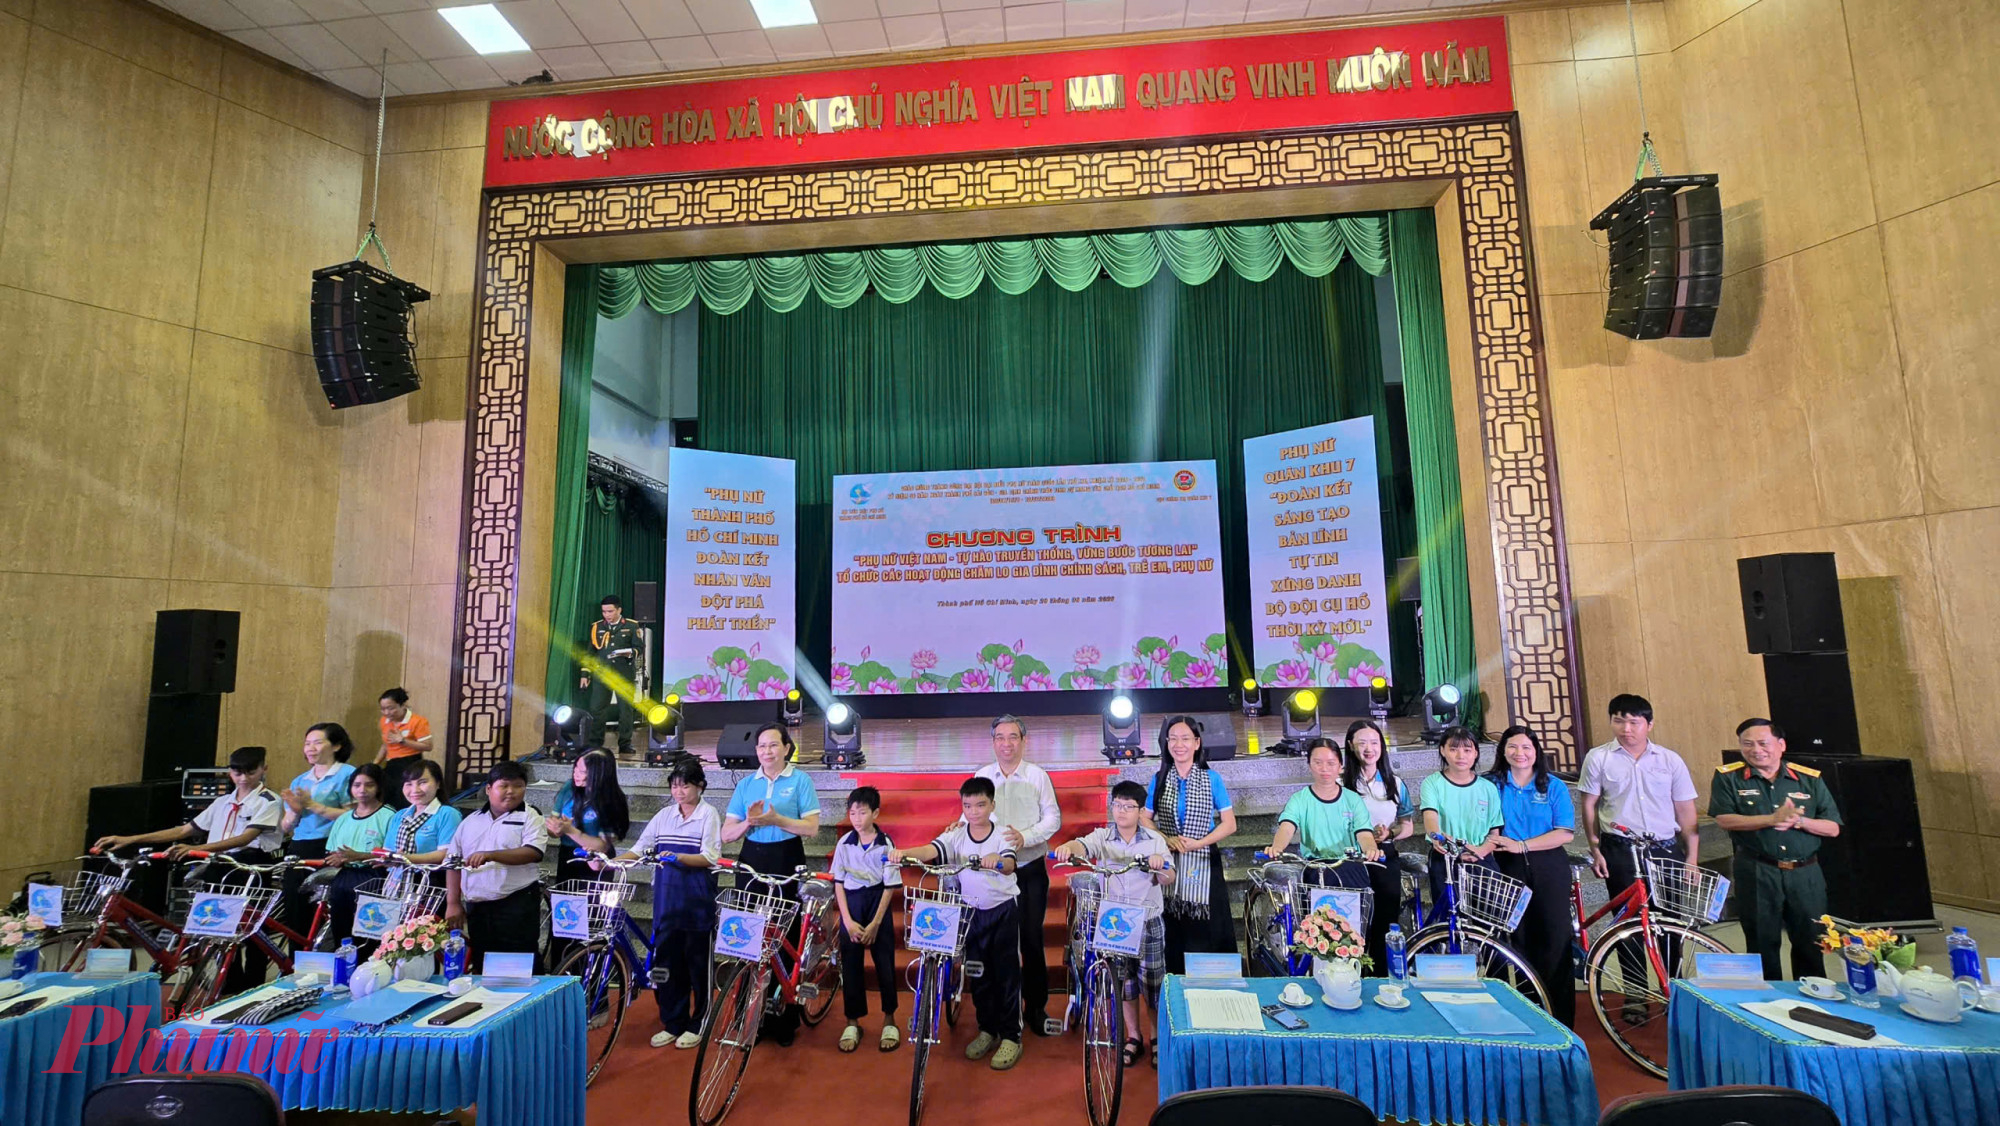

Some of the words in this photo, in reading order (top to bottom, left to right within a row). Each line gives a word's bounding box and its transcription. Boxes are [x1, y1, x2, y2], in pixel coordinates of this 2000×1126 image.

[503, 113, 575, 159] NƯỚC
[581, 109, 654, 161] CỘNG
[661, 101, 716, 146] HÒA
[727, 97, 763, 140] XÃ
[773, 93, 818, 145] HỘI
[828, 82, 883, 130] CHỦ
[895, 81, 978, 127] NGHĨA
[990, 75, 1053, 128] VIỆT
[1065, 73, 1124, 112] NAM
[1136, 67, 1236, 110] QUANG
[1246, 61, 1316, 99] VINH
[1327, 46, 1412, 93] MUÔN
[1421, 40, 1491, 87] NĂM
[1279, 444, 1309, 461] PHỤ
[1312, 437, 1337, 455] NỮ
[1309, 460, 1343, 478] KHU
[1345, 458, 1355, 472] 7
[743, 490, 764, 504] NỮ
[1323, 479, 1352, 497] KẾT
[692, 508, 742, 523] THÀNH
[746, 510, 775, 525] PHỐ
[1274, 508, 1314, 527] SÁNG
[1317, 505, 1350, 523] TẠO
[713, 529, 739, 544] CHÍ
[742, 532, 779, 546] MINH
[926, 528, 1035, 549] CHƯƠNG
[1043, 521, 1122, 545] TRÌNH
[1312, 527, 1348, 544] LĨNH
[696, 550, 740, 565] ĐOÀN
[743, 551, 769, 566] KẾT
[882, 552, 898, 566] NỮ
[899, 552, 921, 567] VIỆT
[923, 552, 947, 565] NAM
[956, 552, 970, 566] TỰ
[972, 549, 993, 562] HÀO
[995, 547, 1035, 562] TRUYỀN
[1077, 545, 1105, 560] VỮNG
[1107, 545, 1136, 558] BƯỚC
[1138, 545, 1172, 557] TƯƠNG
[1289, 554, 1311, 571] TỰ
[1312, 552, 1339, 566] TIN
[694, 572, 738, 587] NHÂN
[853, 569, 879, 583] CHỨC
[881, 568, 903, 582] CÁC
[904, 568, 932, 583] HOẠT
[933, 567, 961, 582] ĐỘNG
[963, 565, 994, 580] CHĂM
[996, 567, 1010, 579] LO
[1012, 565, 1030, 578] GIA
[1032, 564, 1058, 577] ĐÌNH
[1060, 562, 1093, 576] CHÍNH
[1129, 559, 1148, 574] TRẺ
[1151, 561, 1171, 574] EM,
[1173, 561, 1195, 574] PHỤ
[1197, 558, 1214, 572] NỮ
[1271, 576, 1314, 593] XỨNG
[1317, 573, 1361, 589] DANH
[701, 594, 733, 610] ĐỘT
[735, 594, 764, 609] PHÁ
[1265, 600, 1287, 618] BỘ
[1289, 598, 1318, 616] ĐỘI
[1320, 598, 1343, 614] CỤ
[687, 615, 726, 630] PHÁT
[1266, 621, 1303, 638] THỜI
